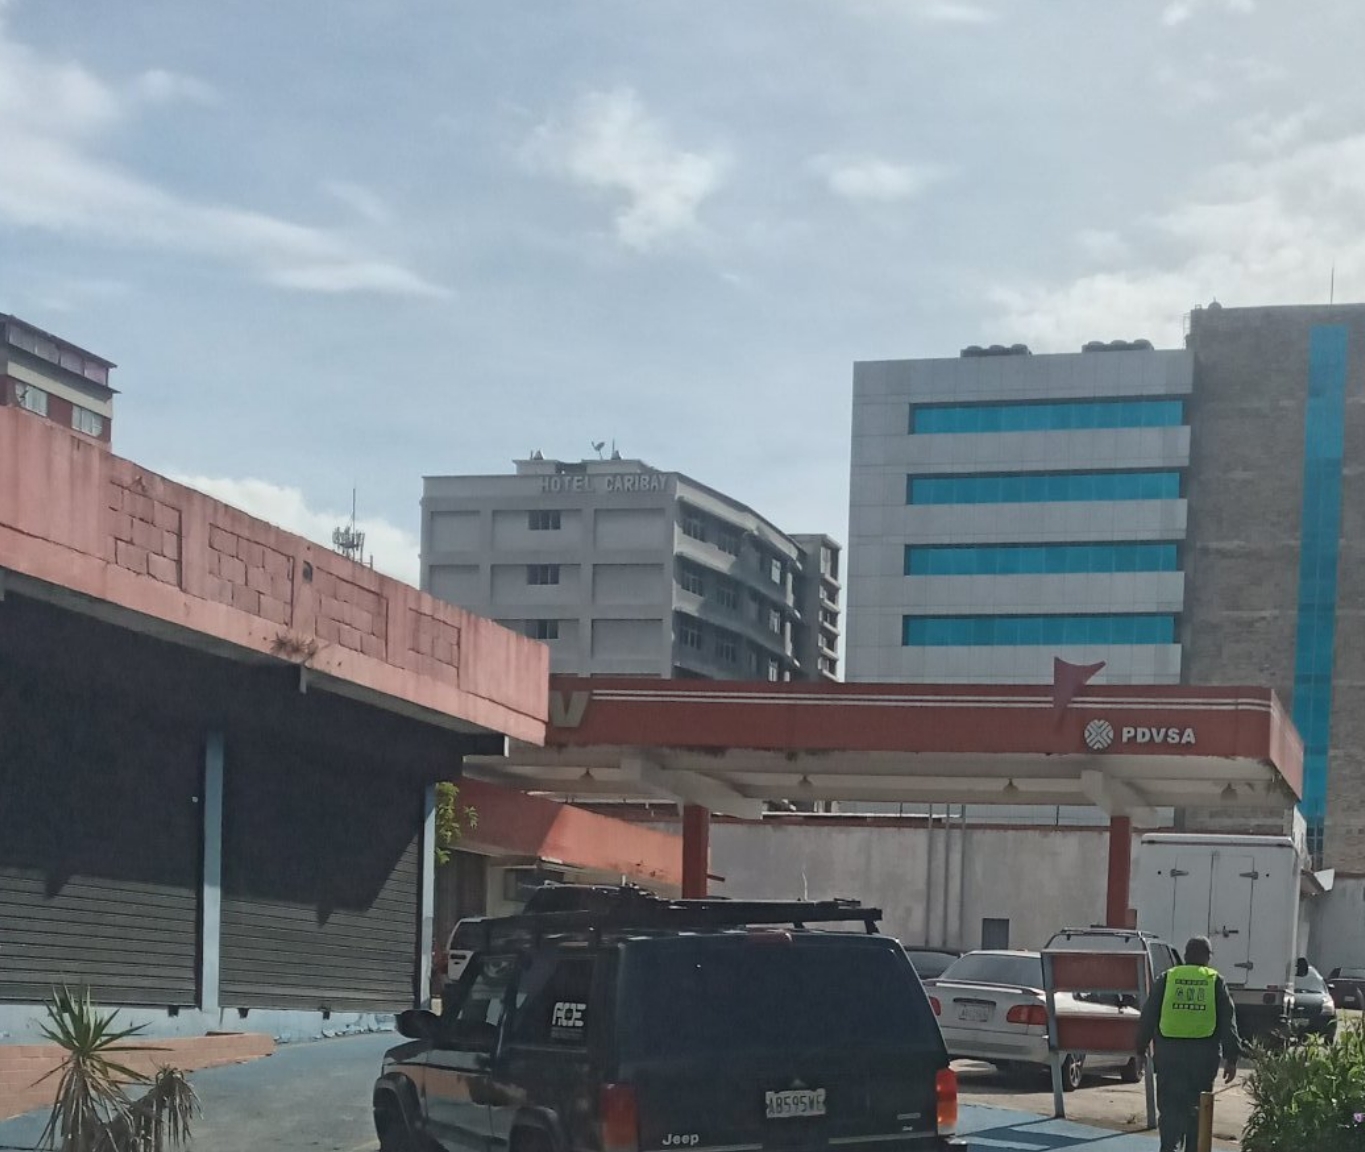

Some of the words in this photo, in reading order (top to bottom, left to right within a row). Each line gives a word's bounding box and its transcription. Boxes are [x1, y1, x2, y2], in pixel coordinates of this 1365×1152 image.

[541, 476, 594, 492] HOTEL
[606, 475, 668, 492] CARIBAY
[1122, 727, 1196, 744] PDVSA
[662, 1133, 699, 1146] Jeep
